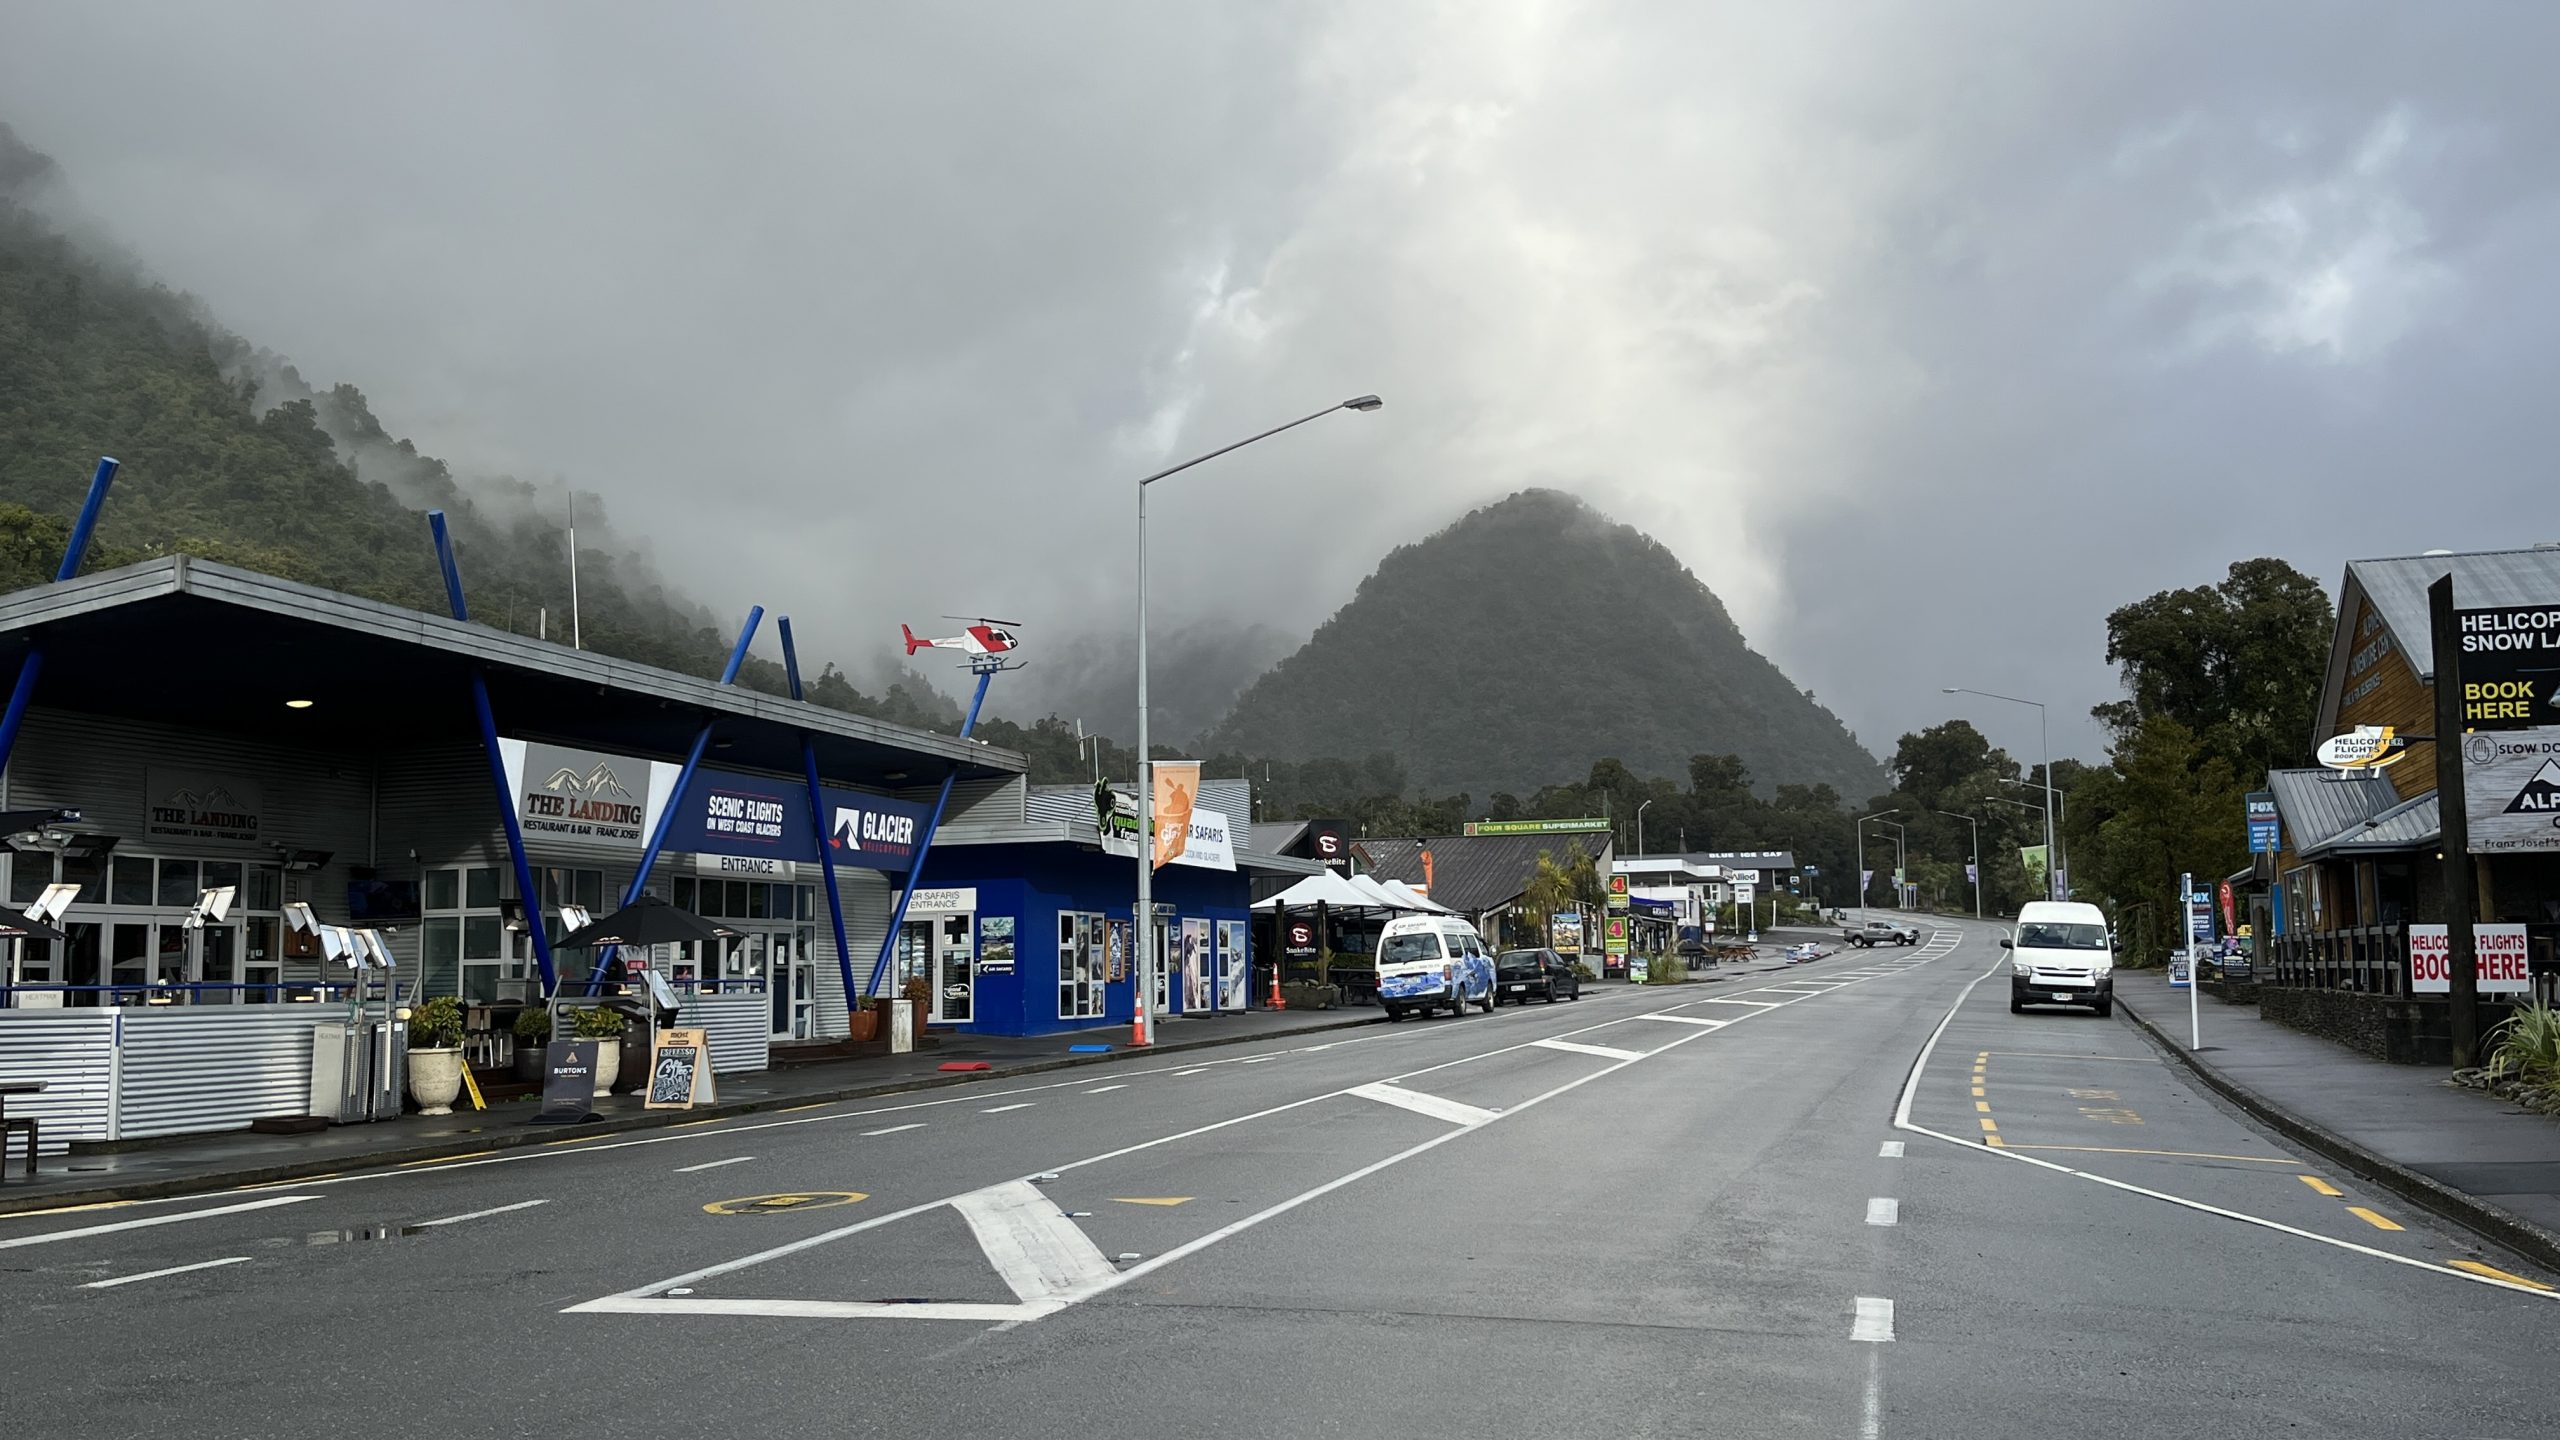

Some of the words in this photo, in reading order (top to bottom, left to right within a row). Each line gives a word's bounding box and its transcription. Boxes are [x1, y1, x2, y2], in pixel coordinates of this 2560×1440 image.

[2462, 632, 2534, 652] SNOW
[2541, 631, 2560, 648] L
[2465, 681, 2535, 700] BOOK
[2466, 701, 2530, 719] HERE
[2335, 737, 2404, 747] HELICOPTER
[2499, 744, 2537, 754] SLOW
[527, 793, 565, 816] THE
[568, 799, 642, 824] LANDING
[708, 795, 744, 819] SCENIC
[746, 799, 783, 823] FLIGHTS
[2249, 801, 2275, 813] FOX
[152, 806, 186, 824] THE
[190, 810, 258, 829] LANDING
[1504, 823, 1541, 831] SQUARE
[1542, 821, 1608, 830] SUPERMARKET
[523, 820, 570, 832] RESTAURANT
[570, 825, 576, 833] &
[577, 825, 592, 835] BAR
[596, 827, 619, 838] FRANZ
[619, 830, 640, 839] JOSEF
[706, 817, 717, 830] ON
[717, 818, 735, 832] WEST
[735, 820, 755, 834] COAST
[755, 823, 782, 837] GLACIERS
[862, 811, 914, 844] GLACIER
[1195, 825, 1223, 842] SAFARIS
[2485, 839, 2516, 848] Franz
[721, 857, 774, 874] ENTRANCE
[1610, 876, 1626, 893] 4
[924, 888, 960, 900] SAFARIS
[911, 900, 957, 909] ENTRANCE
[1607, 920, 1624, 937] 4
[2480, 934, 2525, 950] FLIGHTS
[2413, 953, 2450, 980] BOO
[2475, 953, 2527, 980] HERE
